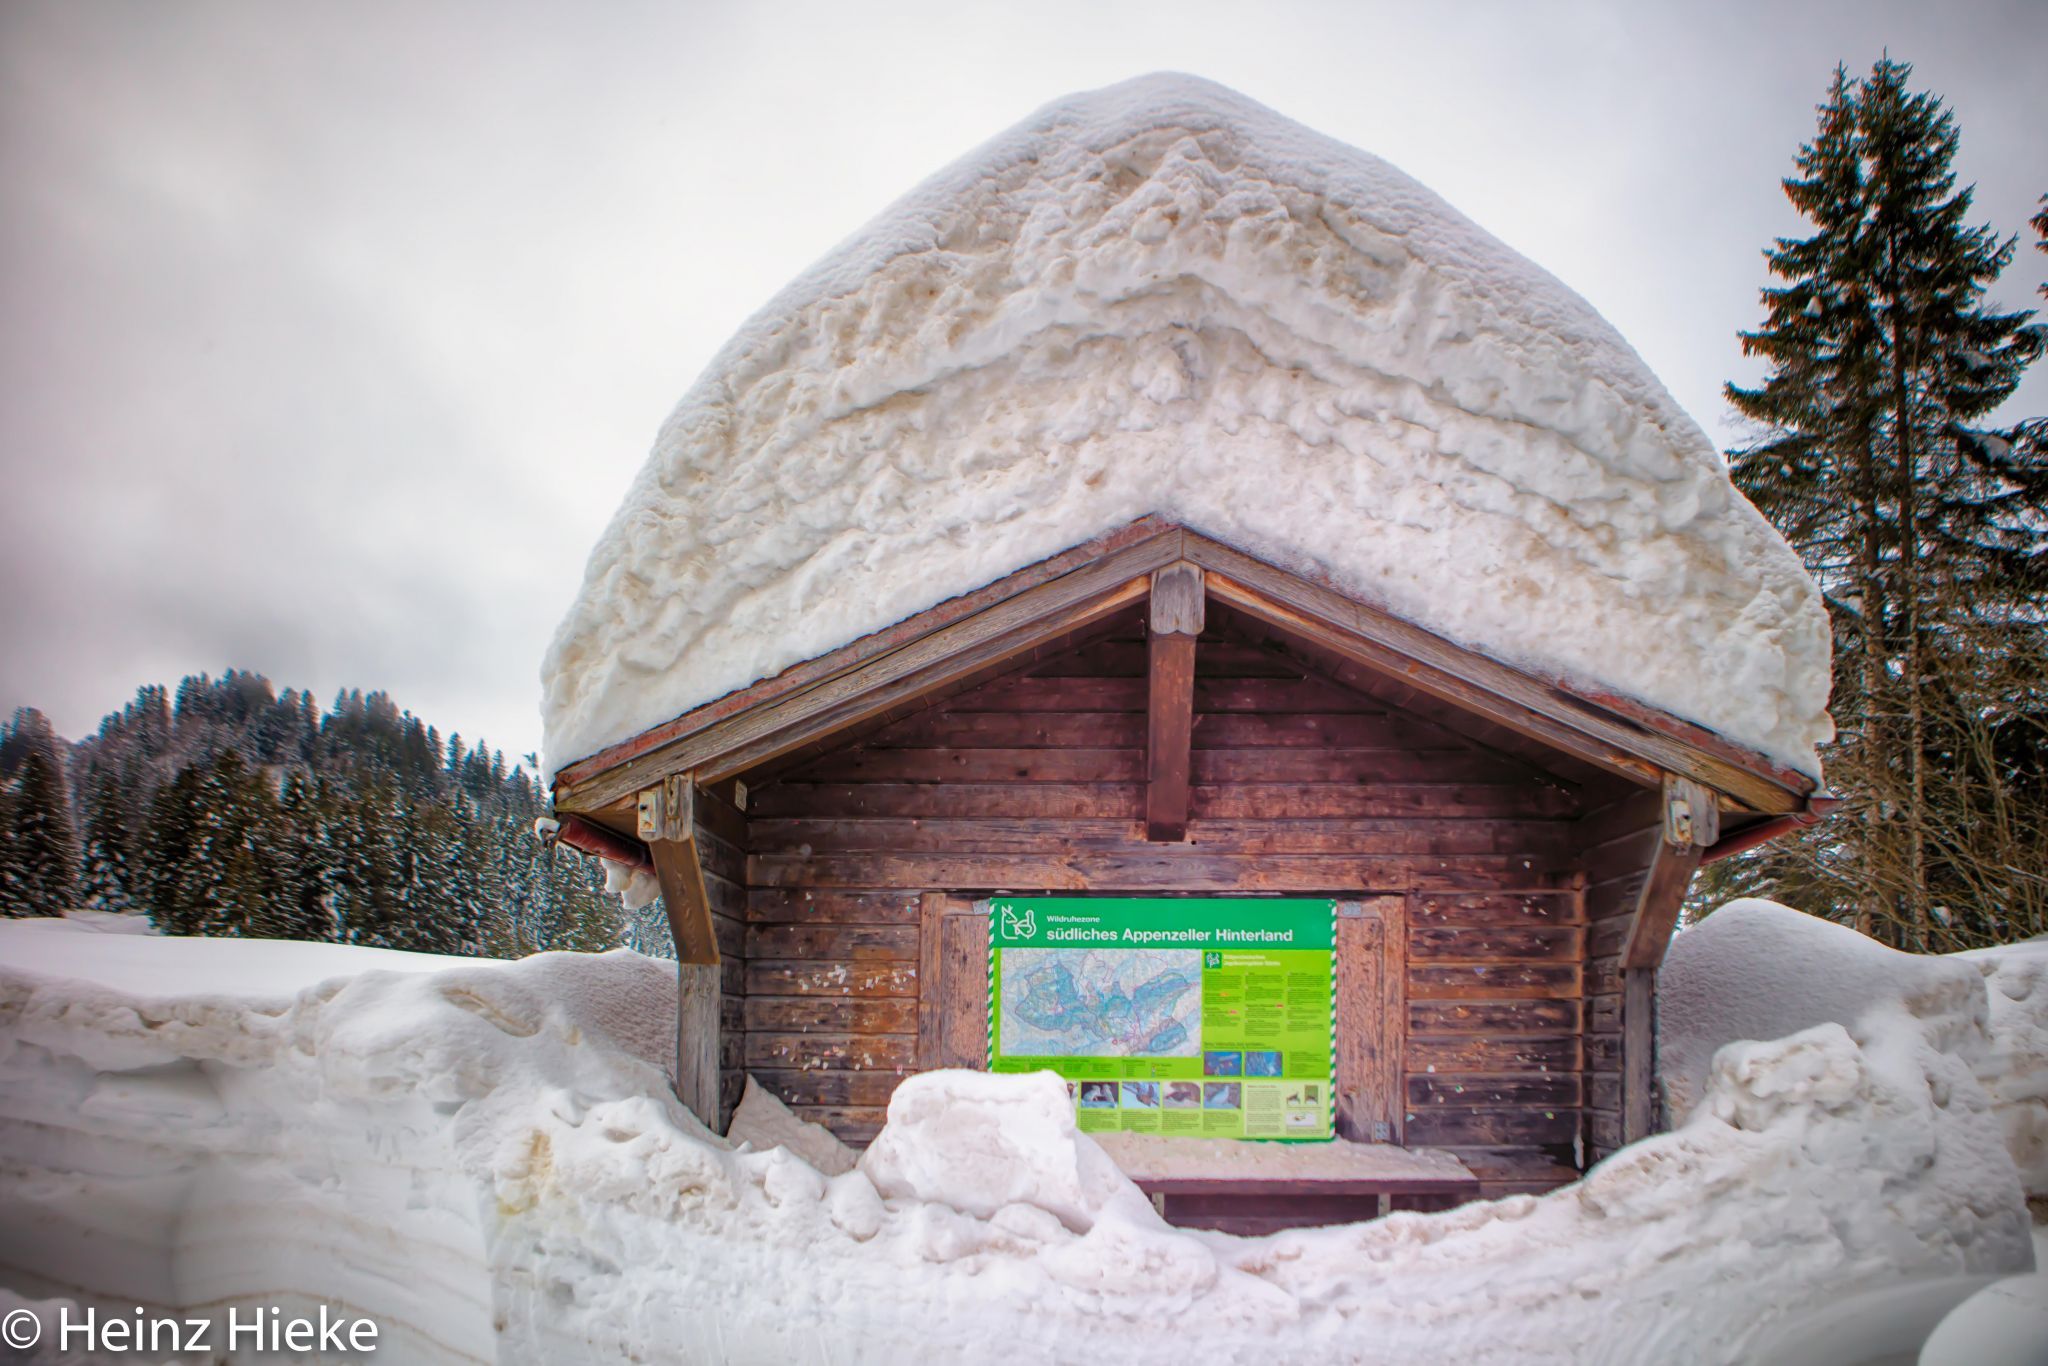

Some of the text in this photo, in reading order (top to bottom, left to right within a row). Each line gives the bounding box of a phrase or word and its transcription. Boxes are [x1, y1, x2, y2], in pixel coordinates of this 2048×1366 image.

[1047, 915, 1101, 924] Wildruhezone
[1047, 928, 1294, 944] südliches Appenzeller Hinterland
